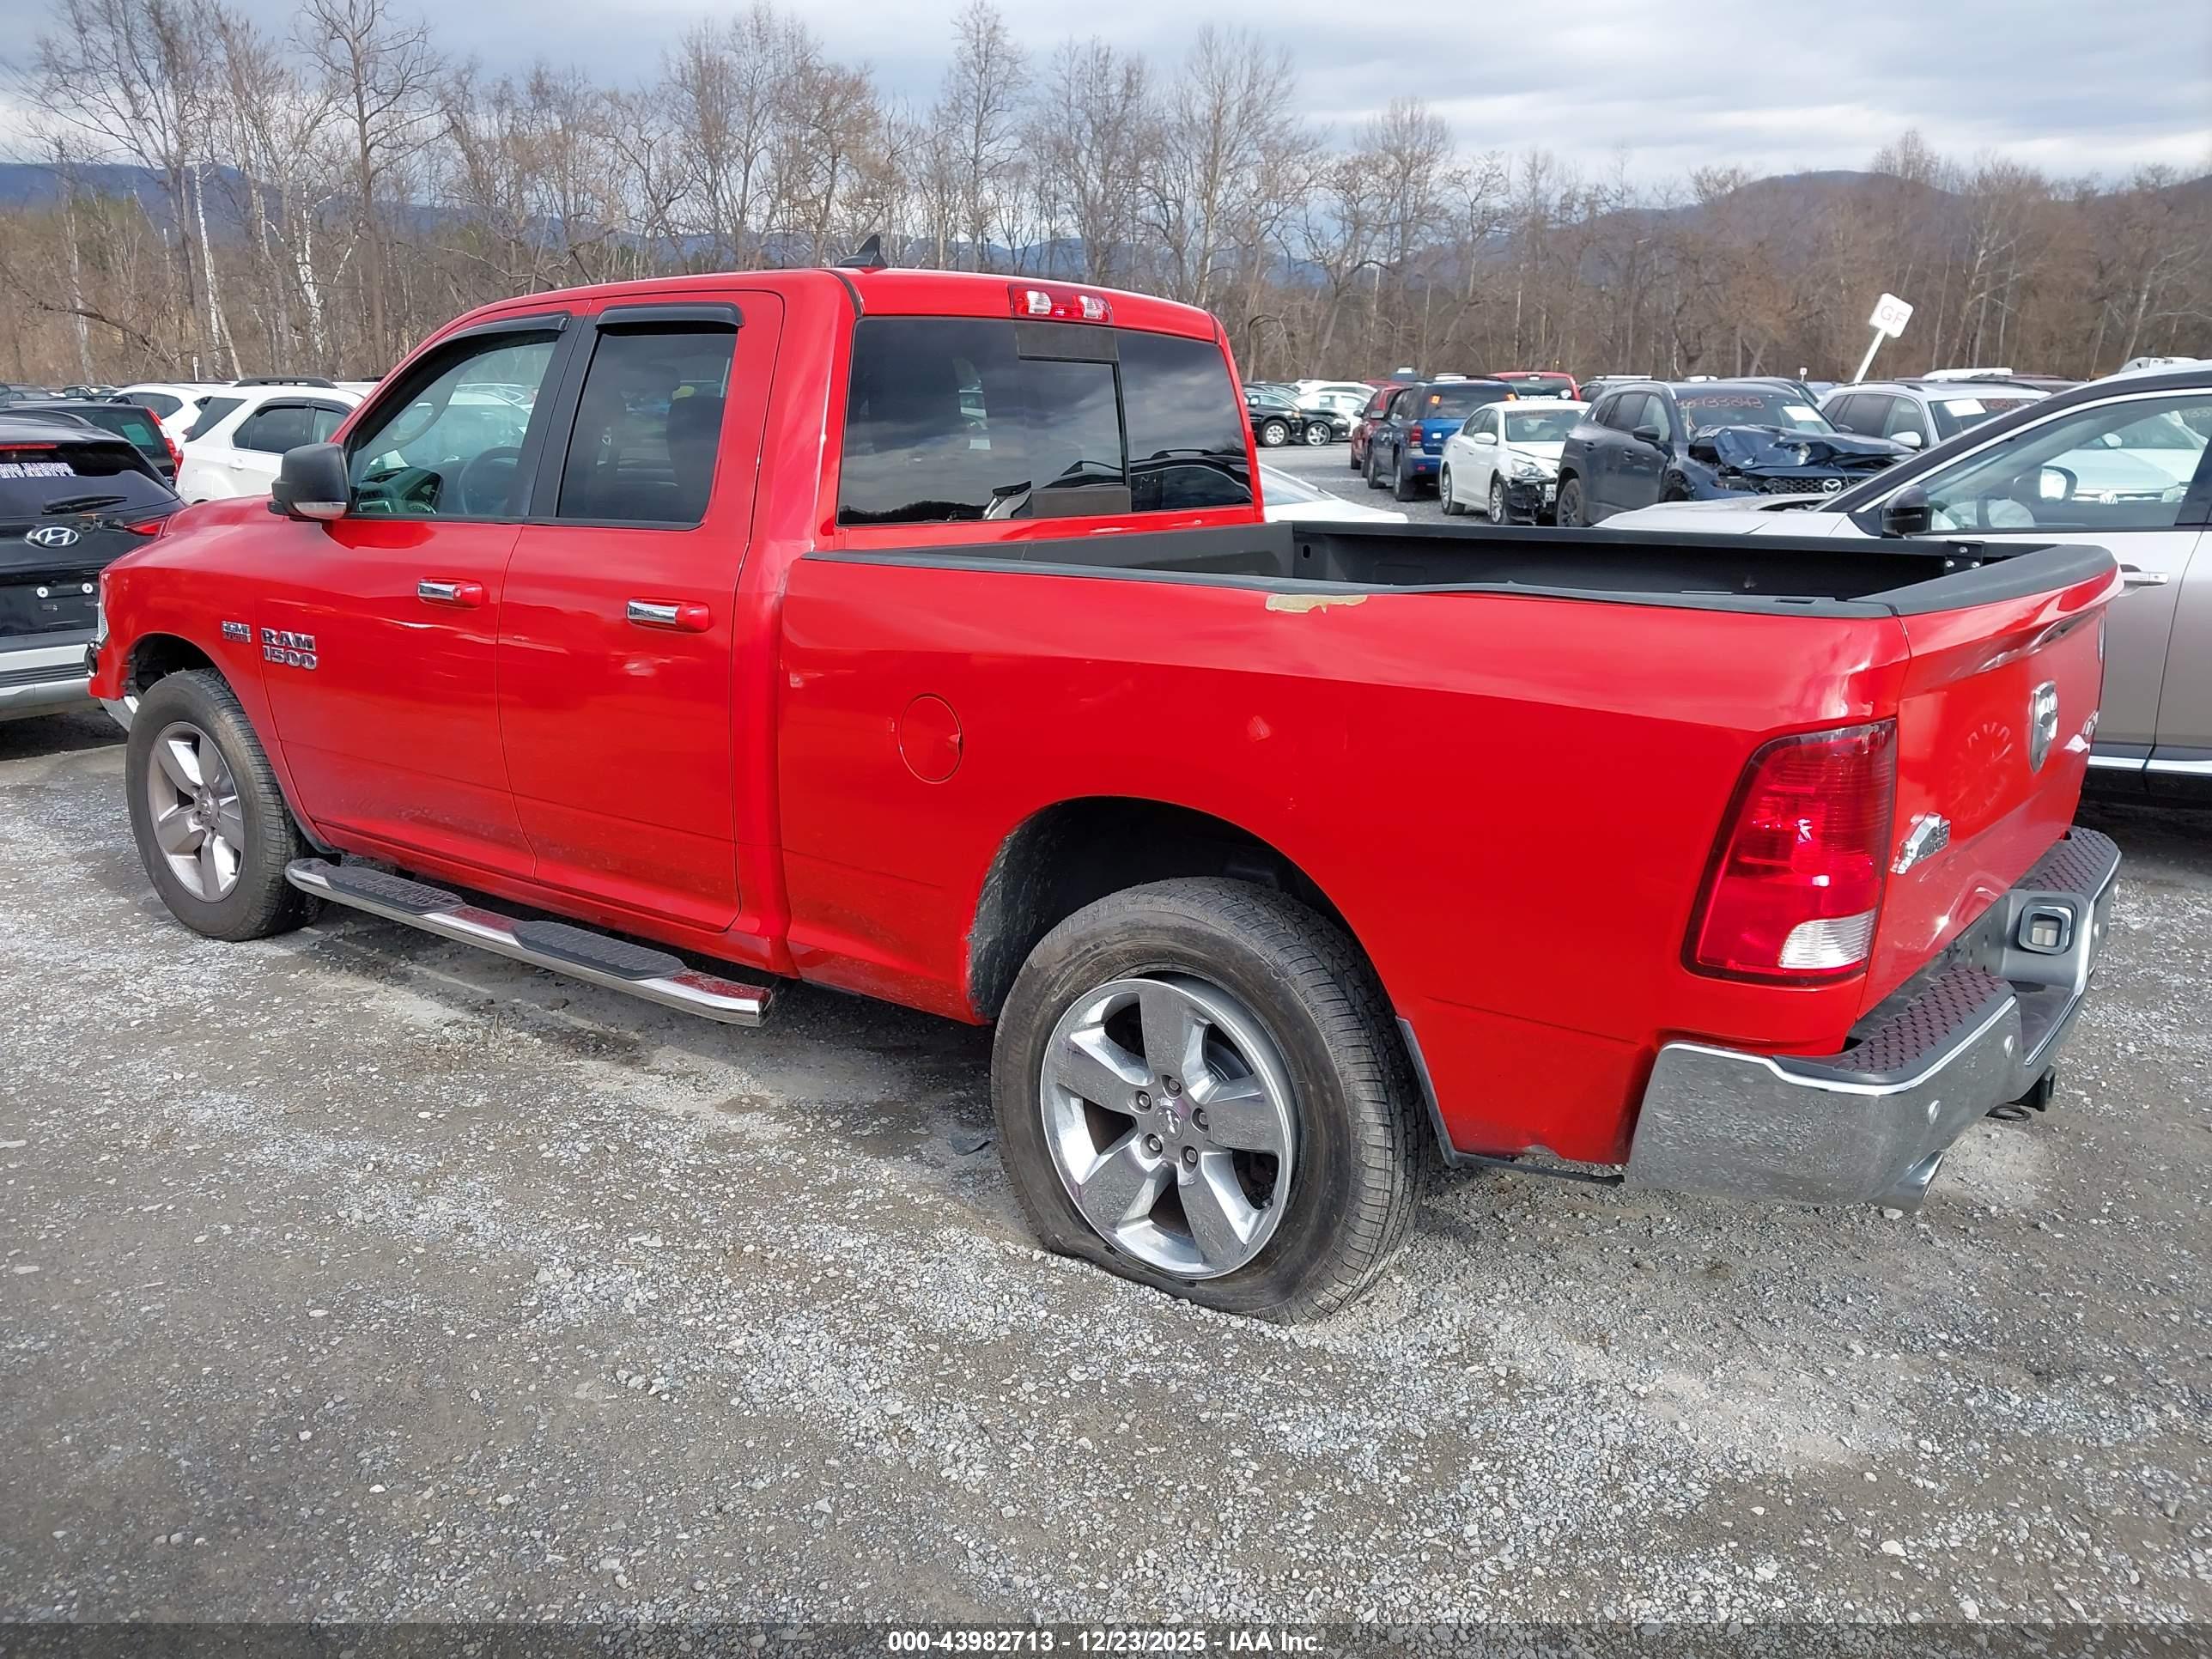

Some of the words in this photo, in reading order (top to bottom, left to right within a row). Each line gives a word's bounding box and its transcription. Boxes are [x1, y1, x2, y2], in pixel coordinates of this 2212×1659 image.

[1880, 305, 1907, 325] GF
[261, 628, 316, 652] RAM
[263, 645, 318, 670] 1500
